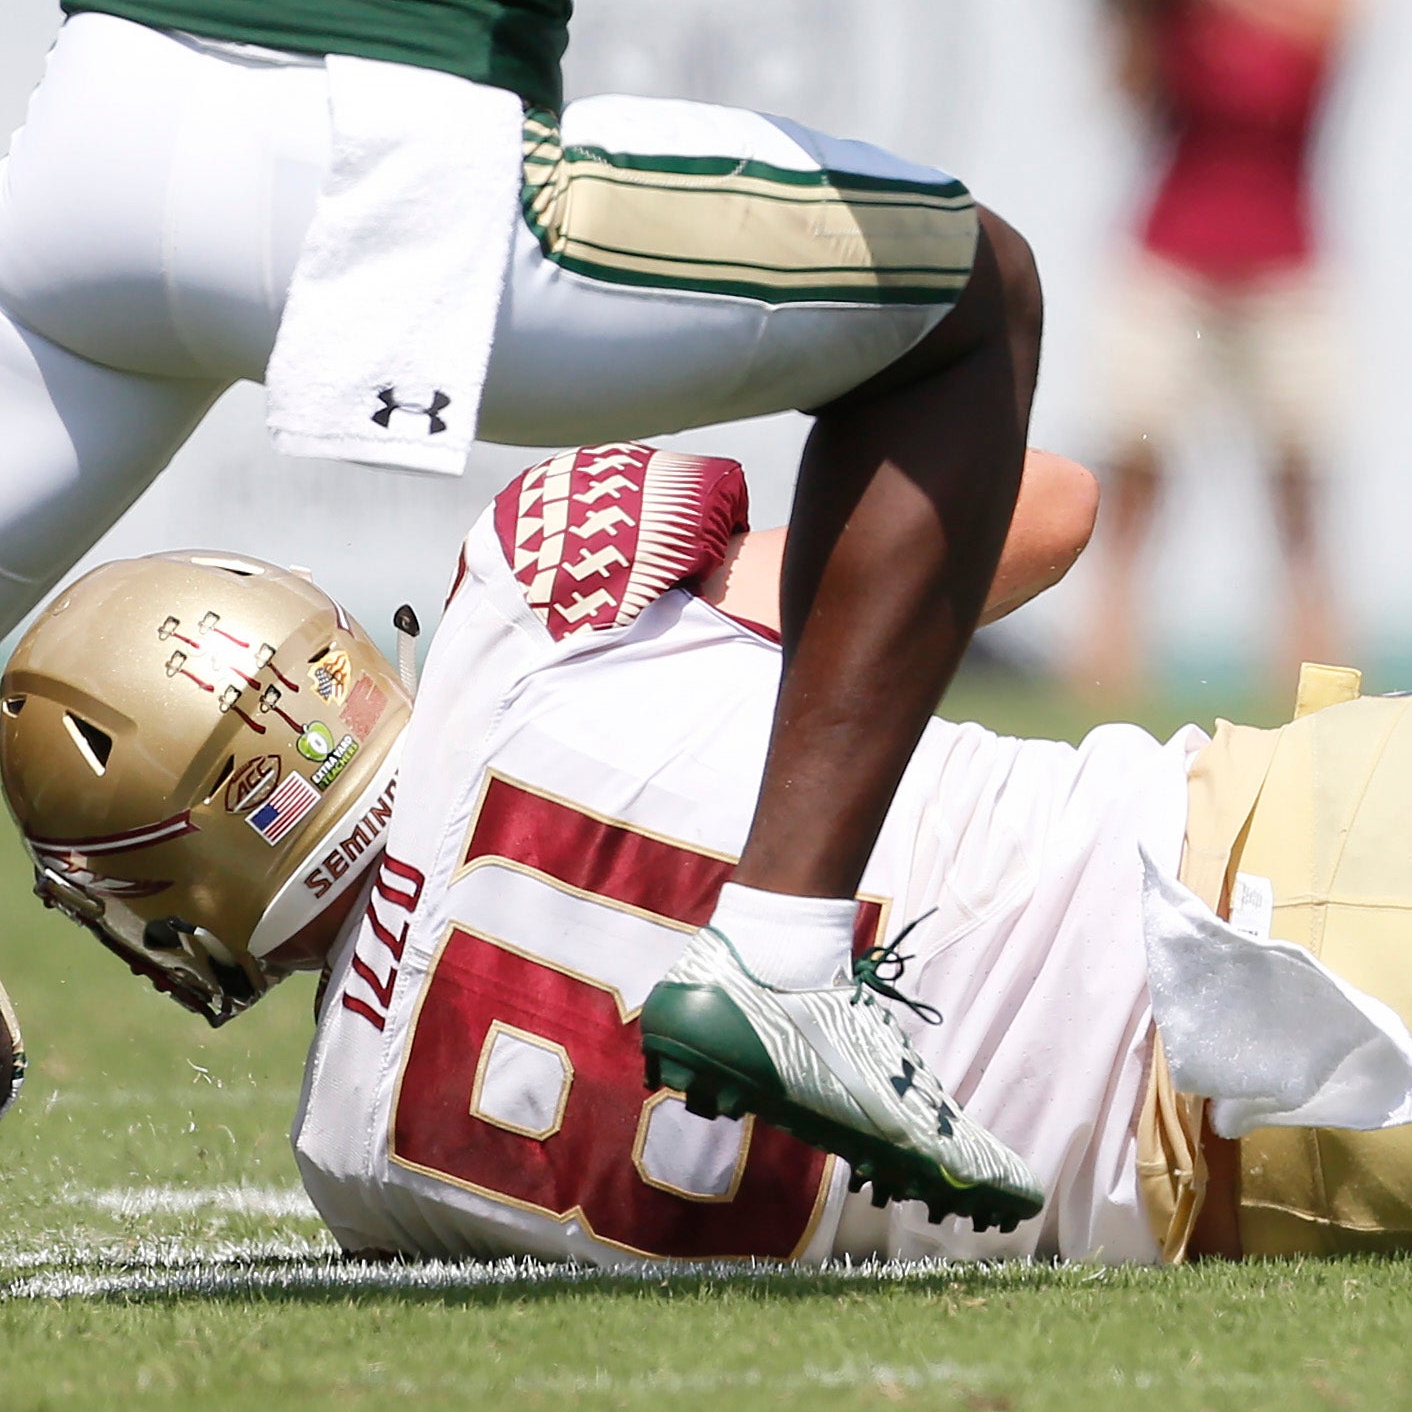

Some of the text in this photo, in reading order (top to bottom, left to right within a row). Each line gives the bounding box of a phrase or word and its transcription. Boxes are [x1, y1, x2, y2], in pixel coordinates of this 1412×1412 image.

[236, 756, 273, 807] ACC
[312, 734, 354, 784] EXTRA YARD
[323, 743, 359, 786] TEACHERS
